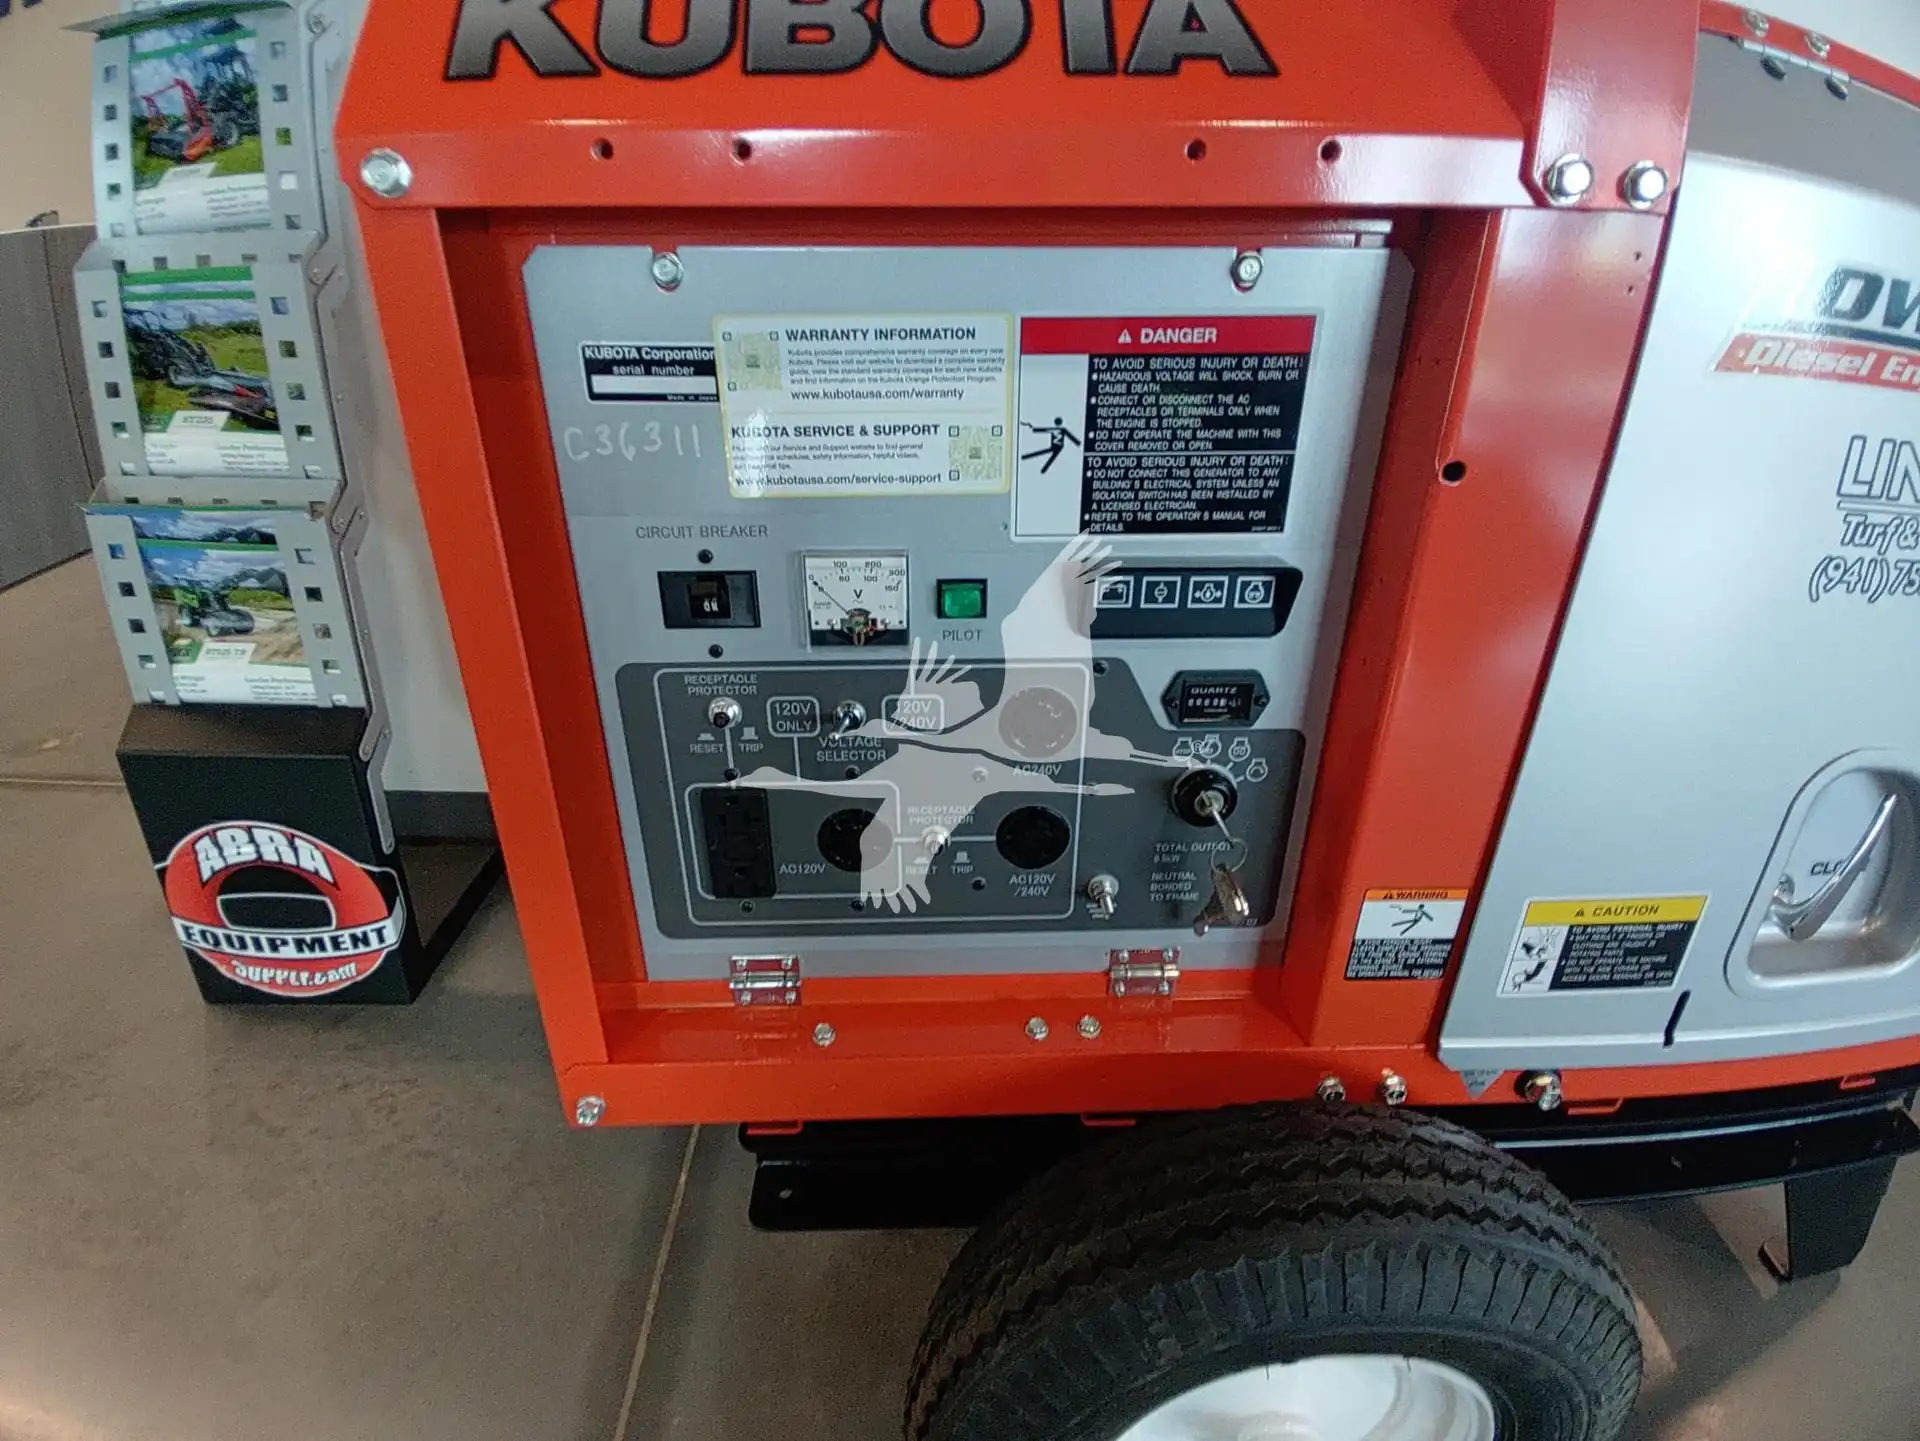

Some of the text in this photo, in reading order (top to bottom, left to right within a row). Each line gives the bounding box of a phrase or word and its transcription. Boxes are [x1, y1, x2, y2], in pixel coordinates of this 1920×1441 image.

[444, 0, 1281, 80] KUBOTA
[785, 327, 976, 341] WARRANTY INFORMATION
[1139, 327, 1218, 344] DANGER
[584, 346, 640, 360] KUBOTA
[1743, 337, 1877, 378] Diesel
[1093, 358, 1108, 369] TO
[1112, 358, 1144, 369] AVOID
[1150, 357, 1196, 369] SERIOUS
[1200, 357, 1238, 369] INJURY
[1242, 357, 1258, 368] OR
[612, 364, 695, 376] serial number
[1099, 372, 1151, 381] HAZARDOUS
[1156, 371, 1194, 381] VOLTAGE
[1199, 371, 1218, 381] WILL
[1258, 370, 1282, 380] BURN
[1286, 370, 1299, 380] OR
[791, 387, 964, 400] www.kubotausa.com/warranty
[1098, 383, 1127, 393] CAUSE
[1098, 394, 1250, 405] CONNECT OR DISCONNECT THE AC
[1097, 406, 1280, 417] RECEPTACLES OR TERMINALS ONLY WHEN
[1097, 419, 1112, 428] THE
[1115, 418, 1146, 428] ENGINE
[1150, 418, 1158, 428] IS
[732, 424, 940, 438] KUBOTA SERVICE & SUPPORT
[1096, 428, 1281, 439] DO NOT OPERATE THE MACHINE WITH THIS
[563, 420, 701, 461] C36311
[1095, 442, 1124, 451] COVER
[1128, 441, 1169, 450] REMOVED
[1172, 441, 1185, 450] OR
[1088, 457, 1102, 467] TO
[1106, 457, 1137, 467] AVOID
[1141, 457, 1186, 467] SERIOUS
[1190, 456, 1226, 466] INJURY
[1230, 456, 1245, 466] OR
[1094, 468, 1280, 478] DO NOT CONNECT THIS GENERATOR TO ANY
[736, 472, 942, 486] ww.kubotausa.com/service-support
[1144, 480, 1192, 489] ELECTRICAL
[1196, 479, 1229, 488] SYSTEM
[1232, 479, 1264, 488] UNLESS
[1268, 479, 1279, 488] AN
[1092, 490, 1274, 500] ISOLATION SWITCH HAS BEEN INSTALLED BY
[1092, 502, 1098, 510] A
[1101, 502, 1140, 510] LICENSED
[1091, 512, 1118, 521] REFER
[1122, 512, 1133, 521] TO
[1137, 512, 1152, 521] THE
[1212, 511, 1245, 520] MANUAL
[1249, 511, 1267, 520] FOR
[636, 525, 768, 539] CIRCUIT BREAKER
[833, 560, 847, 568] 100
[853, 588, 863, 599] V
[941, 629, 982, 642] PILOT
[684, 674, 757, 685] RECEPTACLE
[688, 685, 757, 696] PROTECTOR
[773, 702, 811, 716] 120V
[776, 720, 812, 732] ONLY
[819, 736, 882, 748] VOLTAGE
[690, 743, 724, 753] RESET
[738, 743, 764, 753] TRIP
[816, 750, 886, 762] SELECTOR
[1012, 764, 1062, 777] AC240V
[1155, 843, 1187, 852] TOTAL
[195, 826, 334, 884] ABRA
[779, 863, 826, 874] AC120V
[951, 865, 973, 875] TRIP
[1009, 874, 1056, 885] AC120V
[1151, 872, 1197, 881] NEUTRAL
[1014, 886, 1049, 897] /240V
[1150, 882, 1192, 891] BONDED
[1150, 892, 1200, 901] TO FRAME
[1396, 891, 1449, 900] WARNING
[1592, 904, 1660, 917] CAUTION
[181, 924, 388, 955] EQUIPMENT
